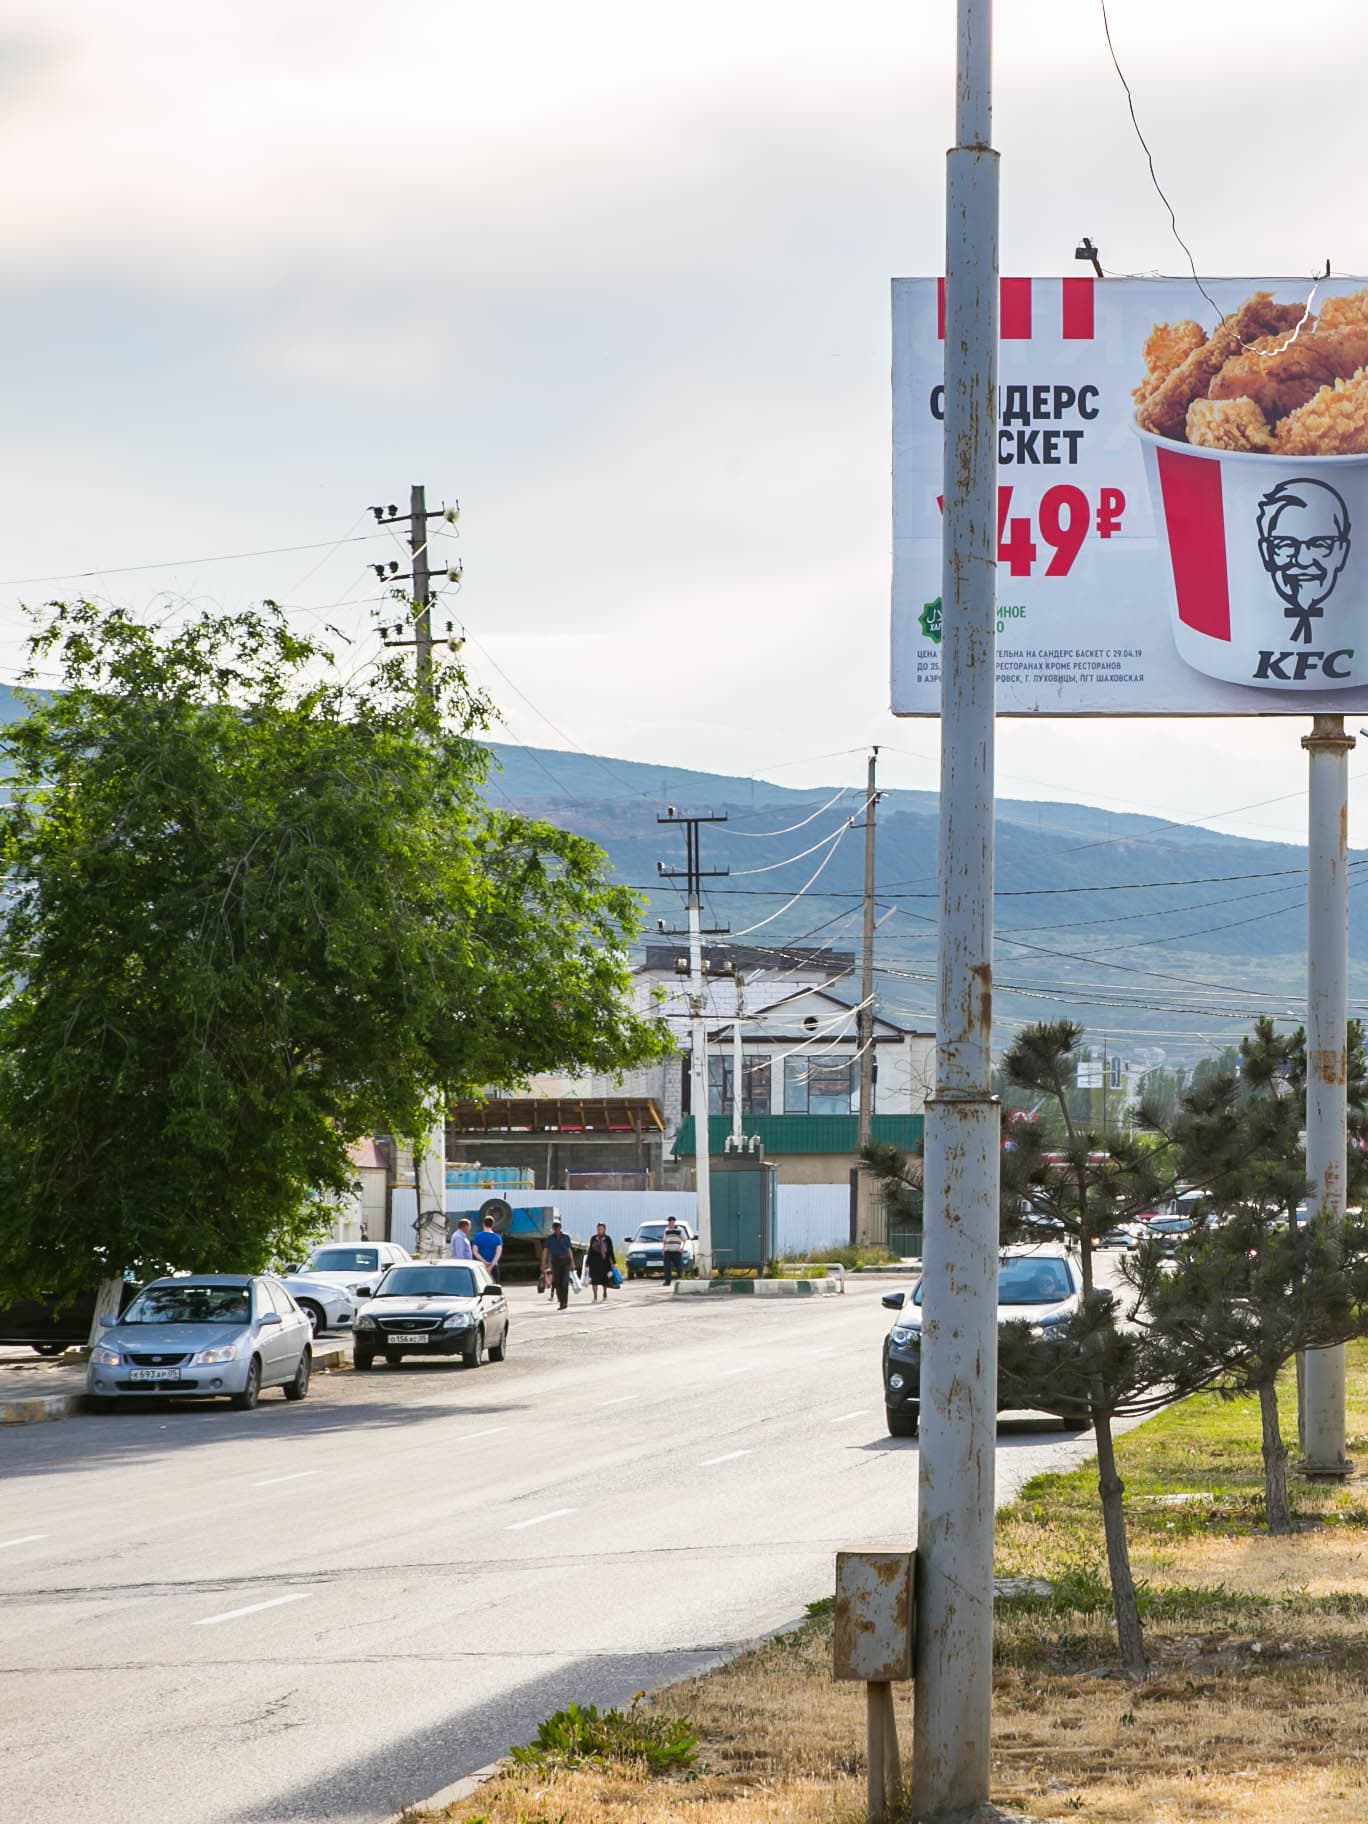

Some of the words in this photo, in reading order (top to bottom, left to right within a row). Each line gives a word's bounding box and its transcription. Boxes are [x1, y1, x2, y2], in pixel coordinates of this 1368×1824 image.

[930, 385, 1100, 426] СДЕРС
[997, 430, 1084, 464] СКЕТ
[917, 650, 937, 659] ЦЕНА
[1026, 650, 1037, 658] НА
[1039, 650, 1073, 659] САНДЕРС
[1075, 650, 1104, 658] БАСКЕТ
[1106, 650, 1111, 658] С
[1253, 649, 1354, 680] KFC
[917, 662, 928, 672] ДО
[1045, 662, 1071, 670] КРОМЕ
[1073, 662, 1121, 670] РЕСТОРАНОВ
[1080, 674, 1094, 683] ПГТ
[1096, 674, 1144, 683] ШАХОВСКАЯ
